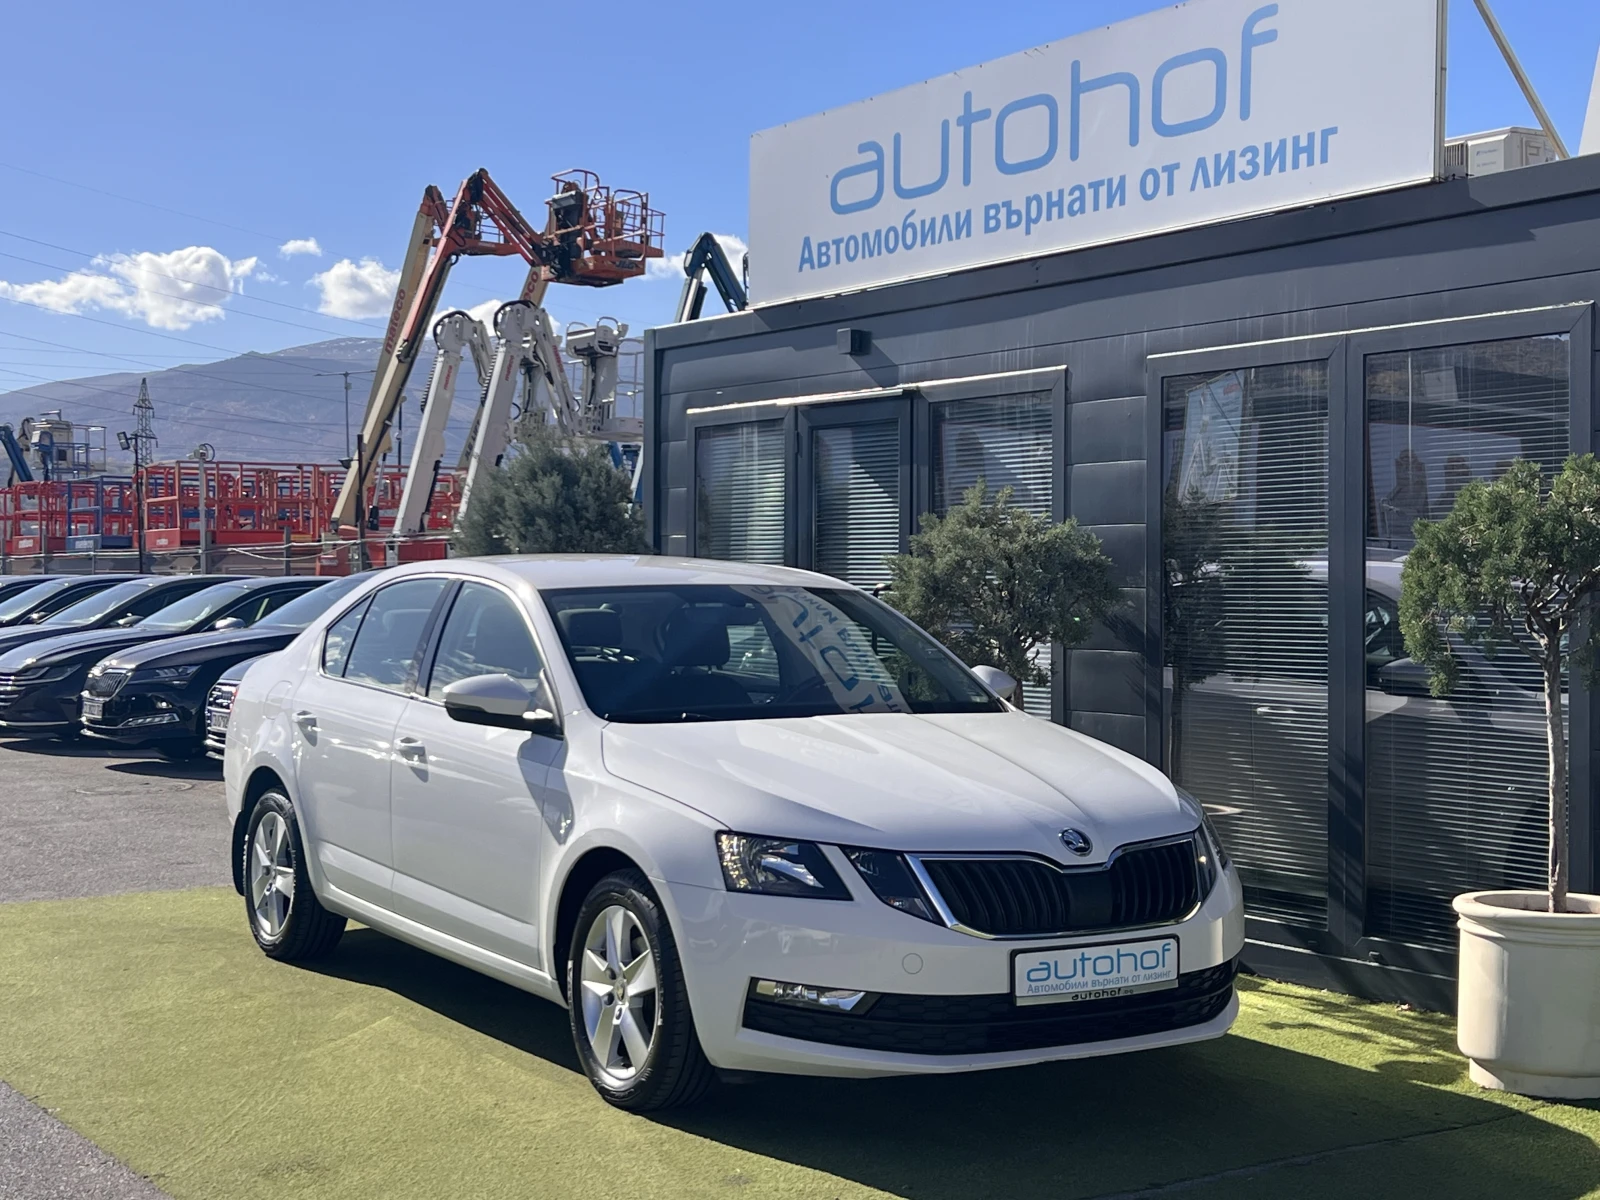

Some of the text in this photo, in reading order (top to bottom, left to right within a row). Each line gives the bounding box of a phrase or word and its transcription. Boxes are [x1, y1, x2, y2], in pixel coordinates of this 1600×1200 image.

[830, 3, 1279, 215] autohof
[798, 126, 1338, 273] Автомобили върнати от лизинг
[385, 288, 406, 355] mateco
[1026, 942, 1171, 983] autohof
[1027, 971, 1172, 994] Автомобили върнати от лизинг
